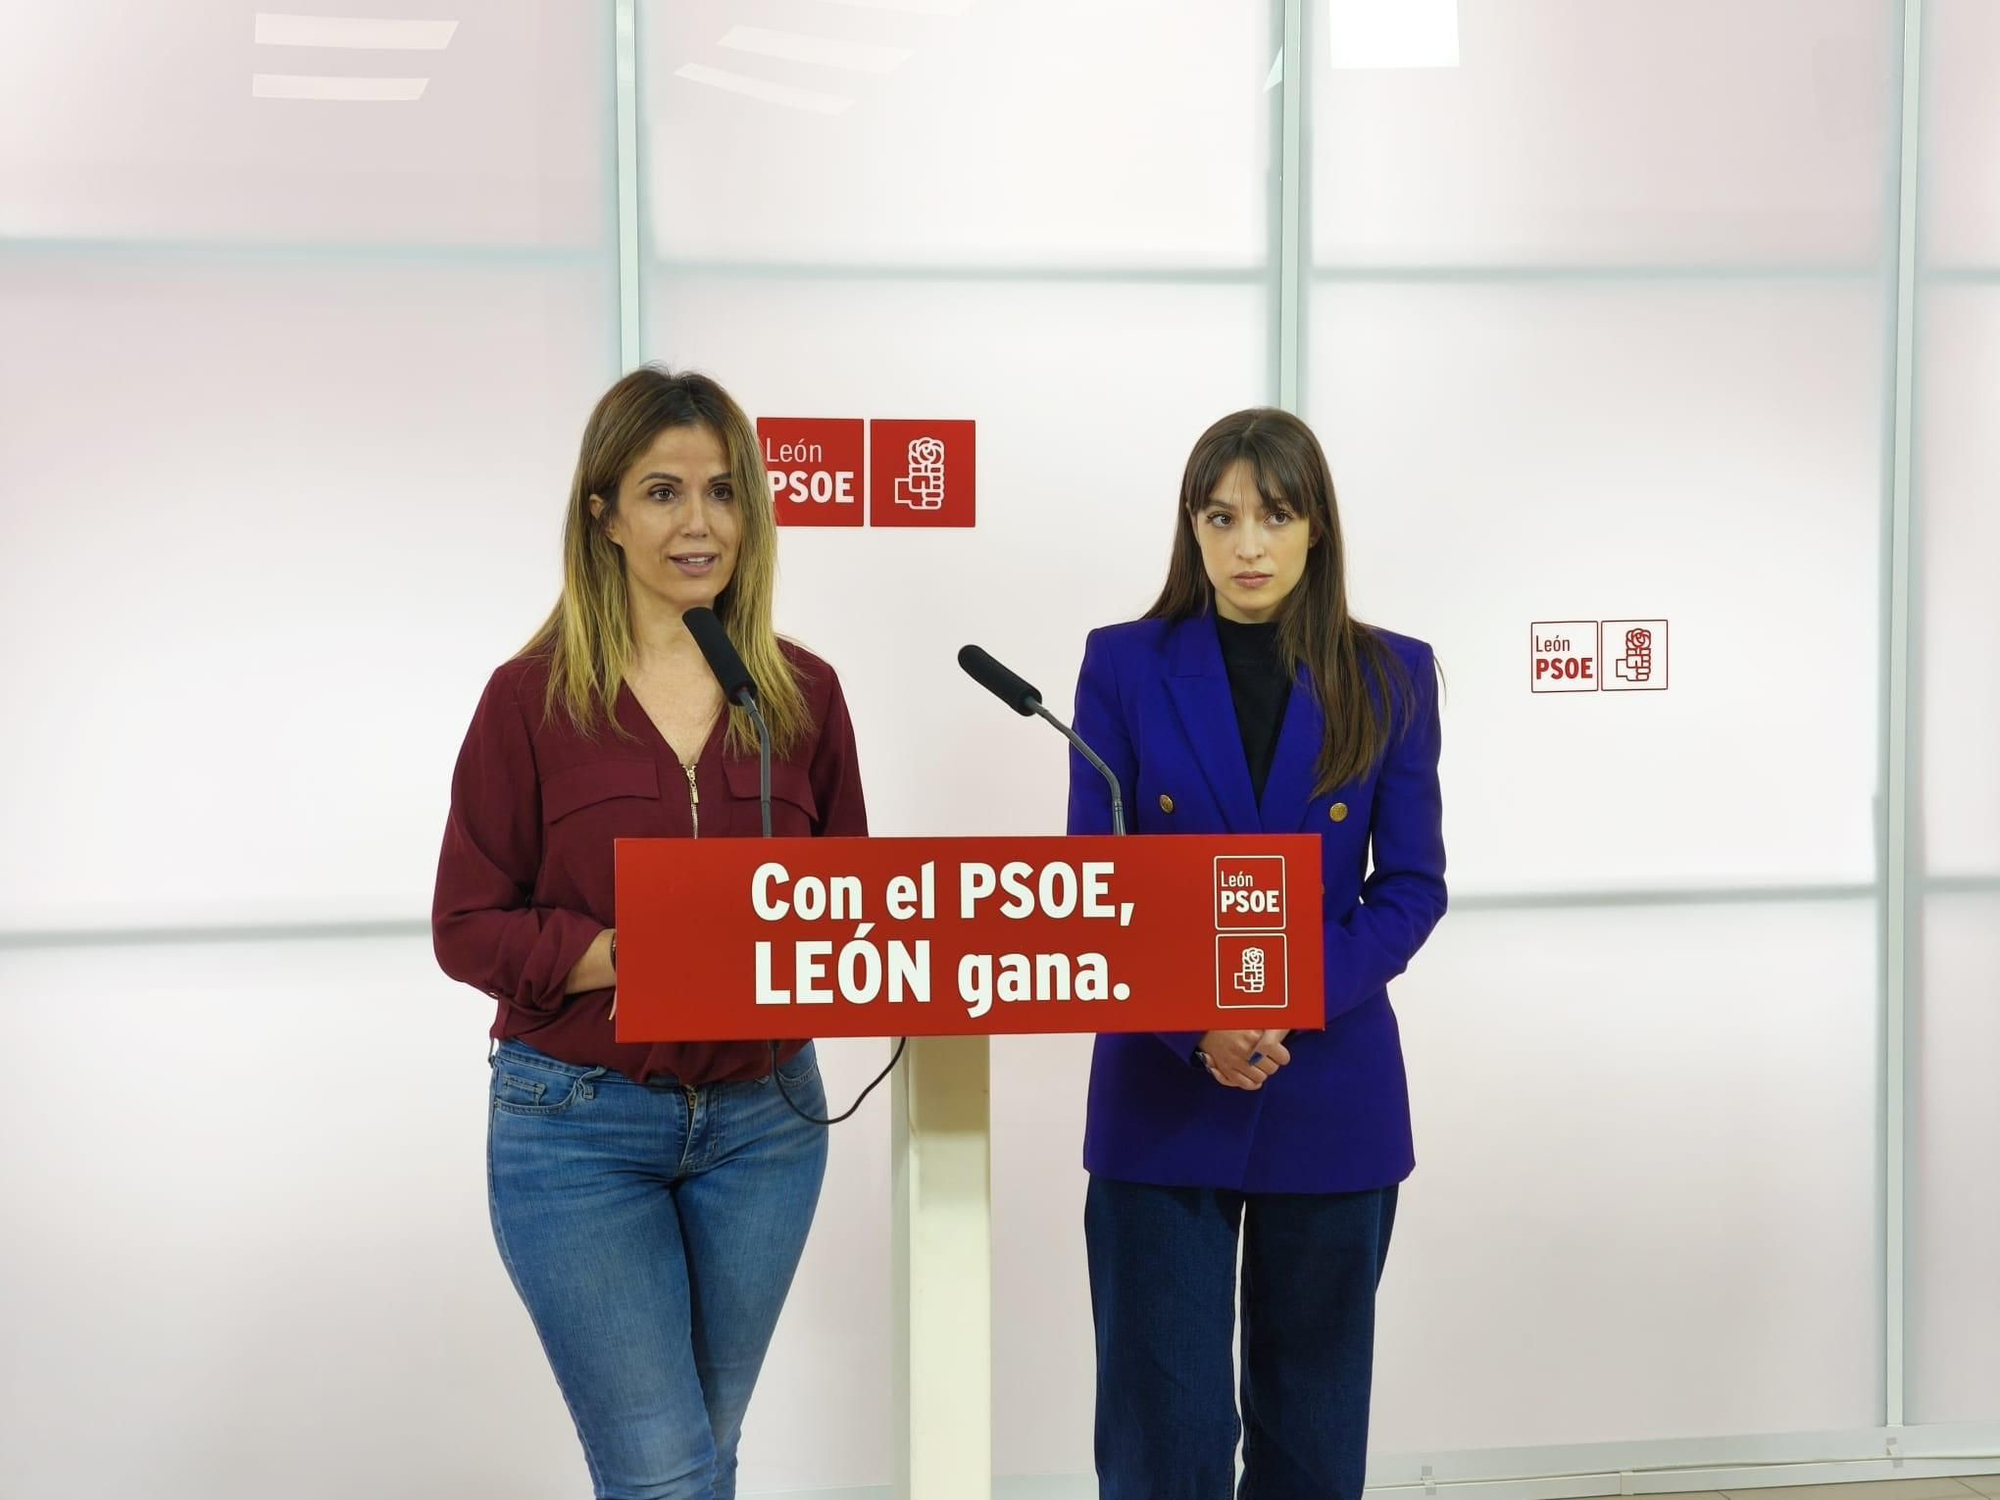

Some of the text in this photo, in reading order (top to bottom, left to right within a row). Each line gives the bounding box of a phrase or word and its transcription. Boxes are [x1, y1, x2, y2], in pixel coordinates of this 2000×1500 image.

[766, 437, 822, 463] León
[766, 470, 855, 503] PSOE
[1536, 635, 1571, 652] León
[1536, 657, 1593, 680] PSOE
[1220, 870, 1254, 888] León
[751, 860, 1135, 926] Con el PSOE,
[1220, 890, 1280, 913] PSOE
[755, 923, 1131, 1018] LEÓN gana.
